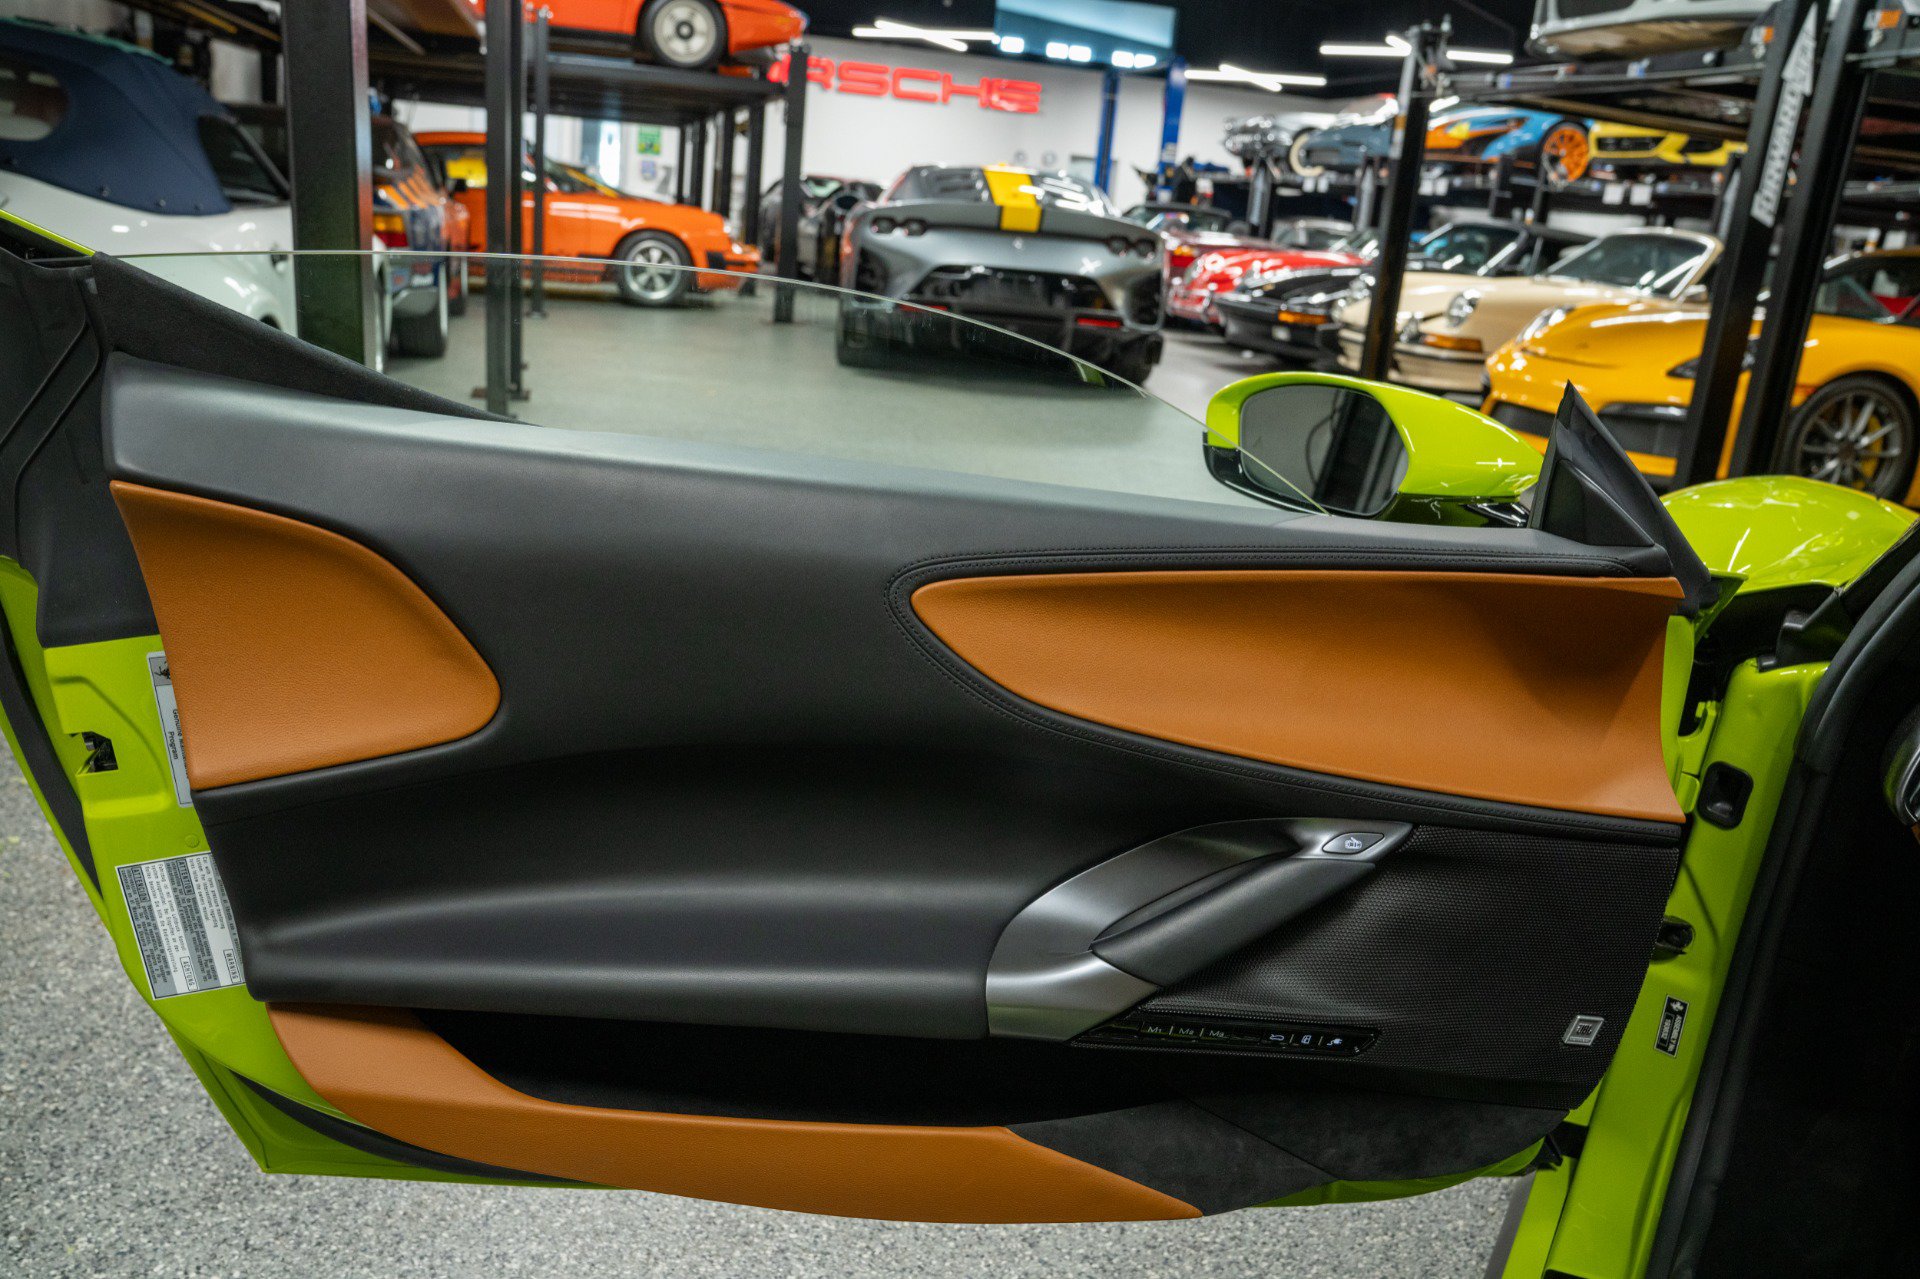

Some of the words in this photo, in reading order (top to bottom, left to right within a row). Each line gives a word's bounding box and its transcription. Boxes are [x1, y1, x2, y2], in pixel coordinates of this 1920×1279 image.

[168, 731, 178, 760] Program
[177, 860, 193, 893] ATTENTION
[182, 960, 195, 986] ACHTUNG
[225, 952, 238, 979] WARNING
